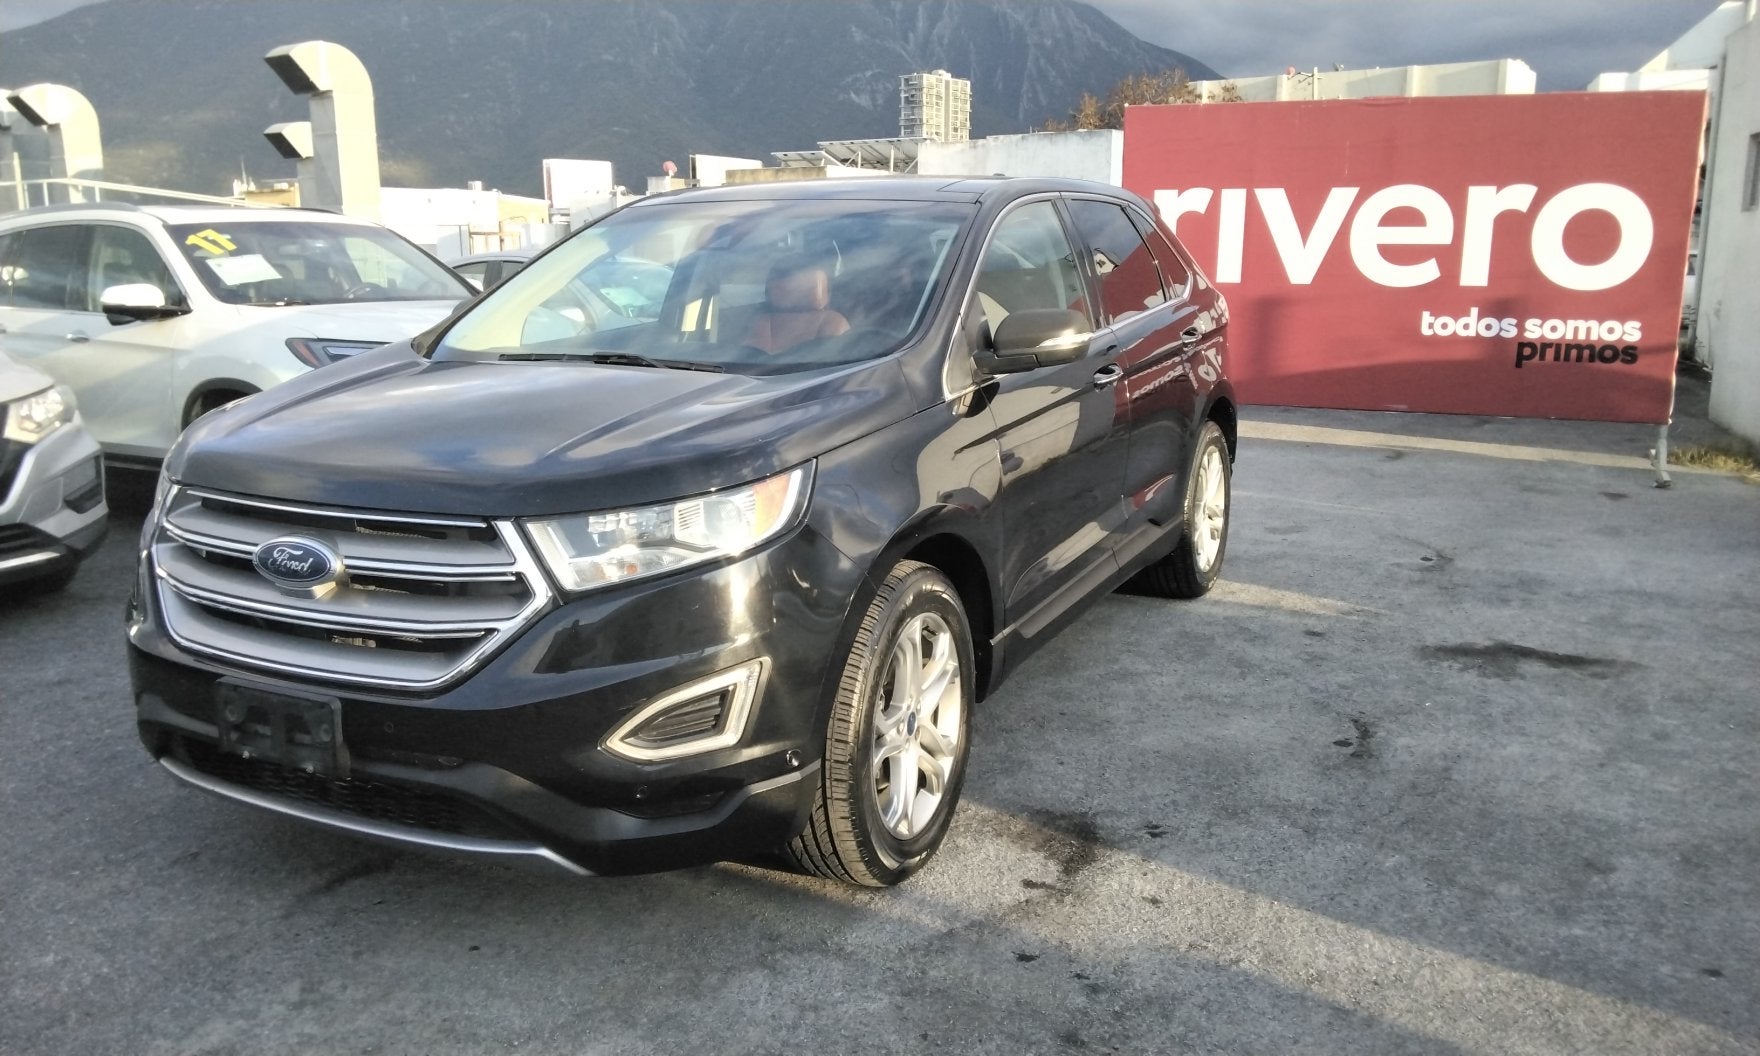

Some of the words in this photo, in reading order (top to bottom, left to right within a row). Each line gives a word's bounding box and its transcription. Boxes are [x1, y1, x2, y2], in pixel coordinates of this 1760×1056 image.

[185, 228, 237, 255] 17
[1153, 183, 1654, 291] rivero
[1421, 307, 1518, 339] todos
[1524, 317, 1642, 343] somos
[1515, 340, 1639, 368] primos
[268, 546, 314, 575] Ford
